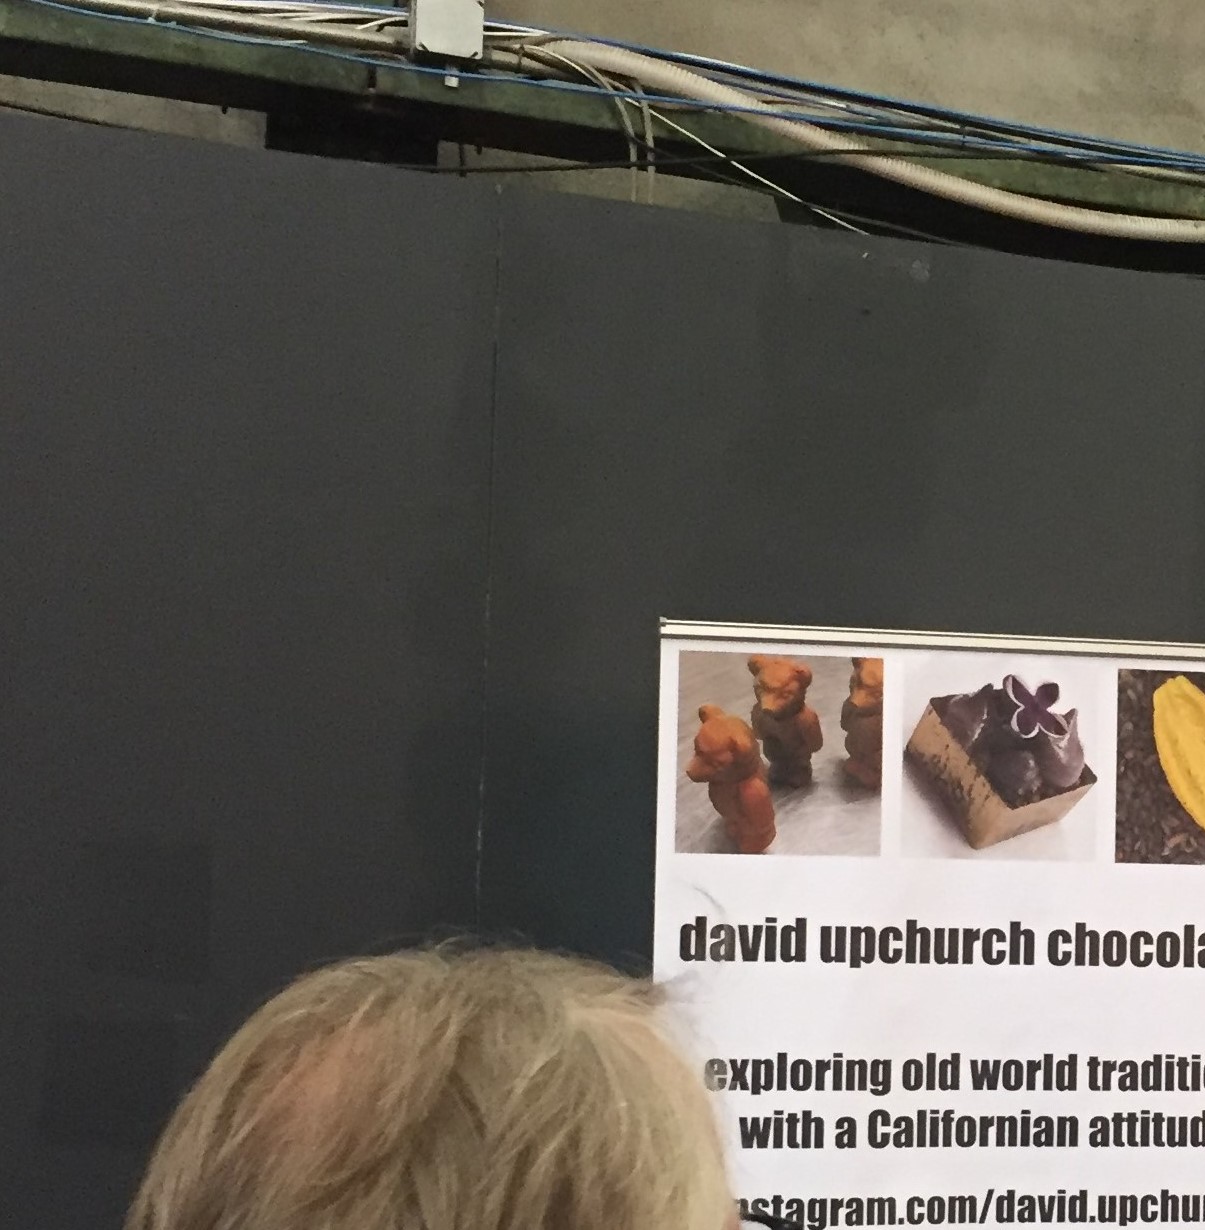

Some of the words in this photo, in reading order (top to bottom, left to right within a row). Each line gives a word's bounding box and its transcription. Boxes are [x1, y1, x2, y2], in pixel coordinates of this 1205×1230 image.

[680, 916, 807, 963] david
[819, 919, 1035, 969] upchurch
[704, 1052, 892, 1097] exploring
[902, 1052, 961, 1092] old
[969, 1053, 1078, 1092] world
[739, 1109, 825, 1149] with
[834, 1116, 857, 1149] a
[867, 1109, 1079, 1149] Californian
